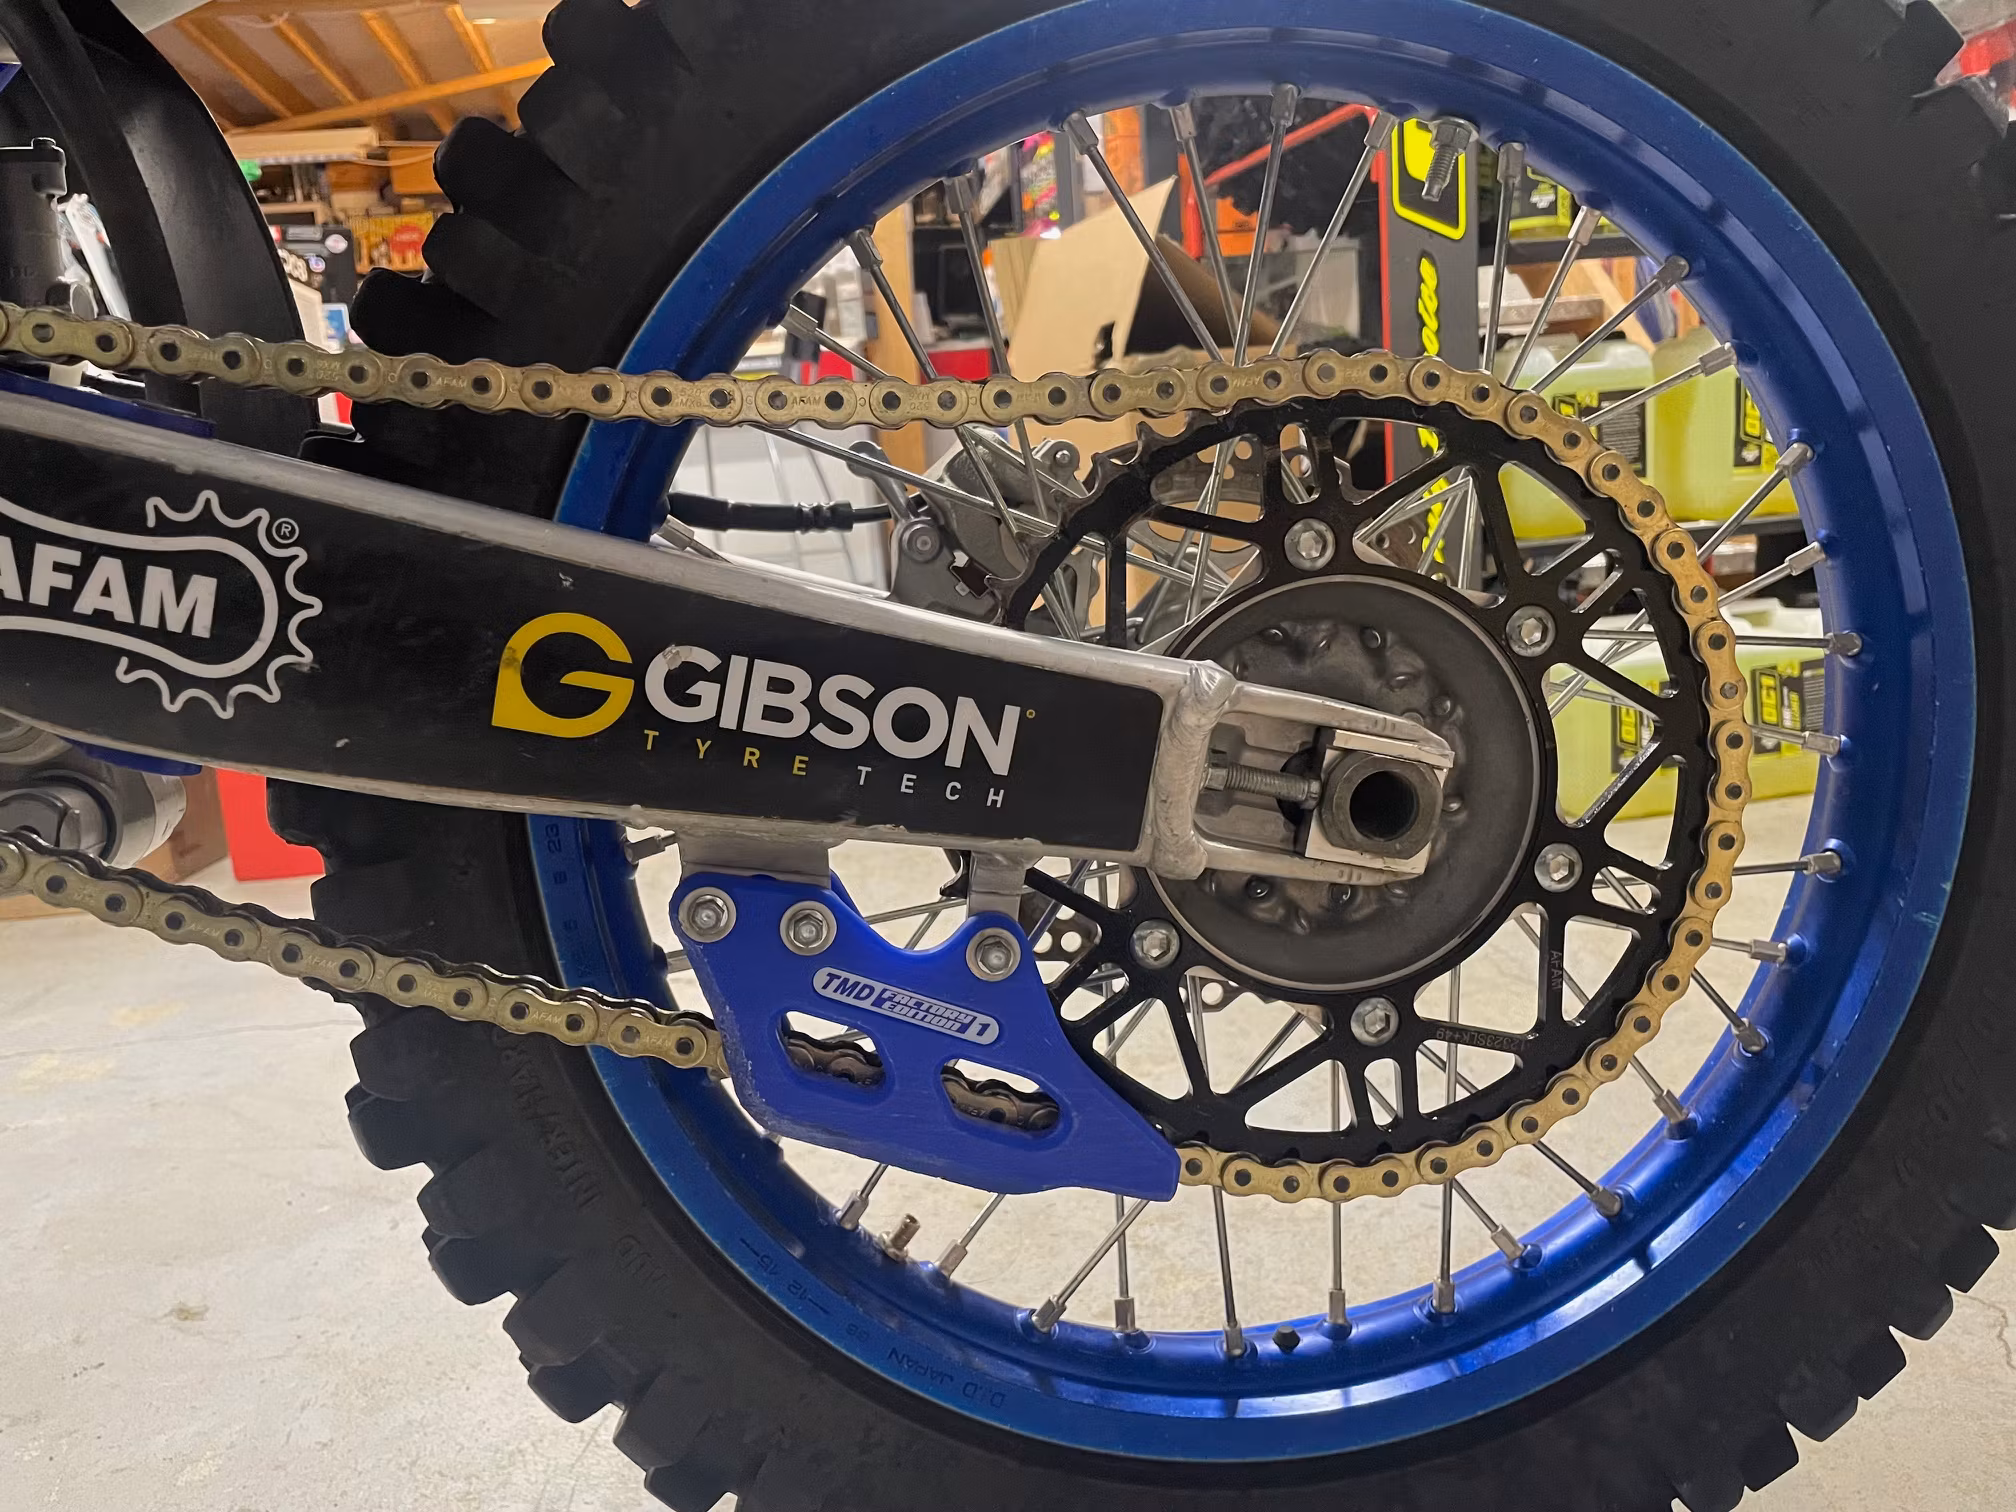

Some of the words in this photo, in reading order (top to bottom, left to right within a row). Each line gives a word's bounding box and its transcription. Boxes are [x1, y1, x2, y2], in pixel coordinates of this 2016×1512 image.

[434, 376, 467, 389] AFAM
[790, 396, 822, 407] AFAM
[644, 645, 1021, 777] GIBSON
[643, 729, 809, 777] TYRE
[857, 765, 1005, 809] TECH
[305, 954, 337, 969] AFAM
[1550, 949, 1563, 991] AFAM
[821, 972, 876, 1002] TMD
[530, 1011, 563, 1025] AFAM
[880, 1001, 964, 1033] EDITION
[881, 989, 976, 1023] FACTORY
[643, 1034, 673, 1048] AFAM
[976, 1022, 991, 1037] 1
[886, 1346, 954, 1386] JAPAN
